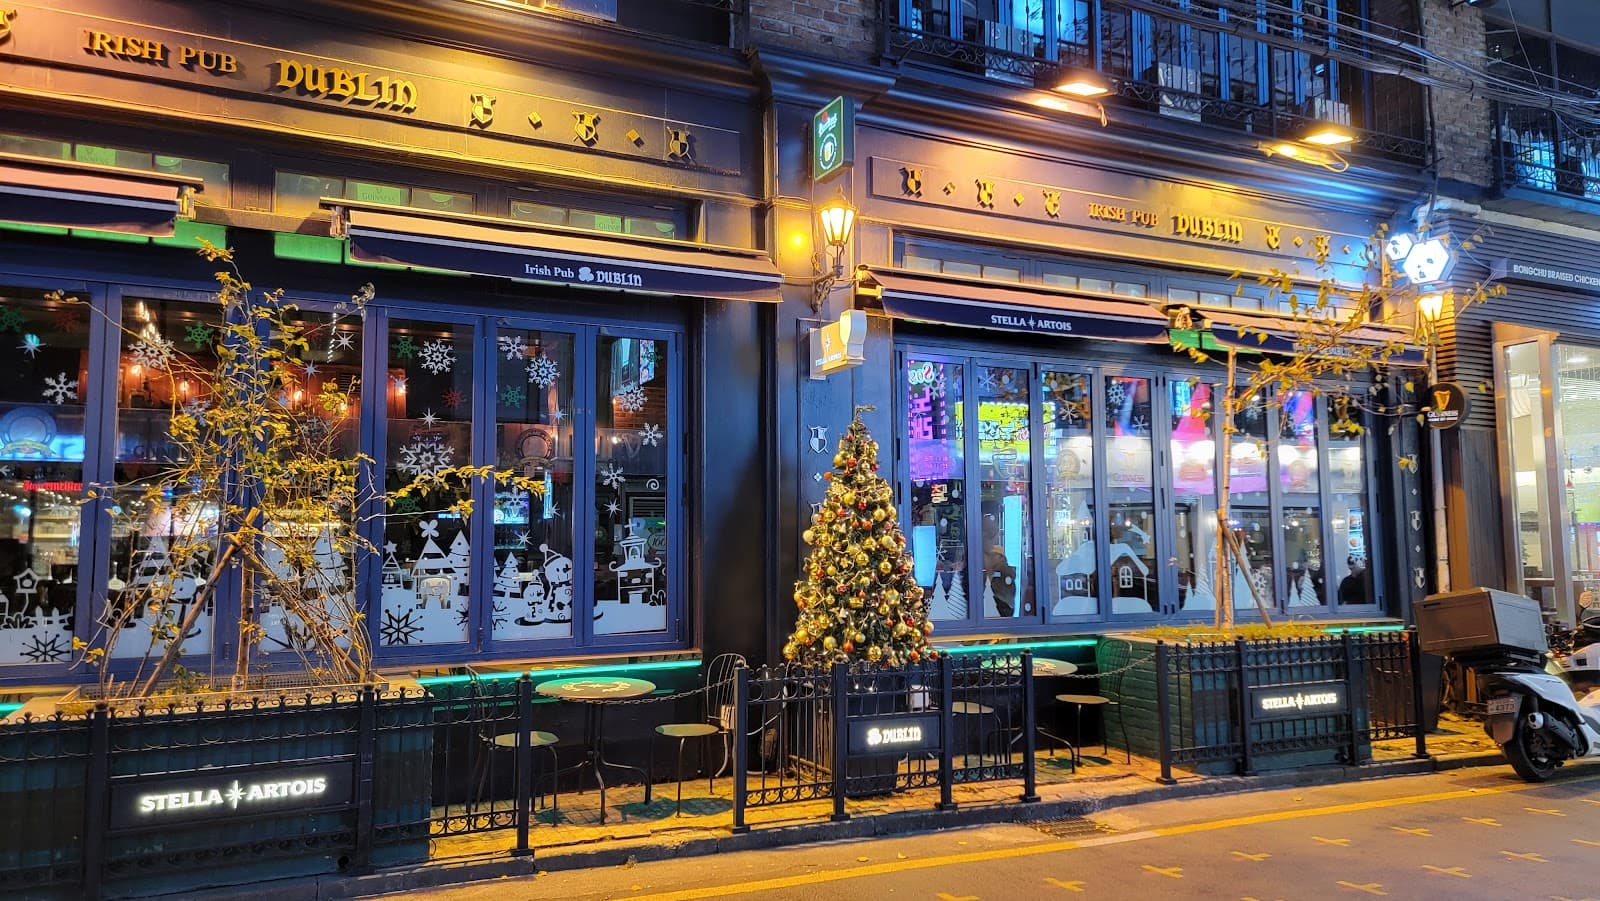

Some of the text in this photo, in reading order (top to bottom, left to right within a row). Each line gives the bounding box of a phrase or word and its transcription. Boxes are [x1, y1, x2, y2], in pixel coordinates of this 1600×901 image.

[84, 30, 418, 110] IRISH PUB DUBLIN
[1088, 202, 1243, 241] IRISH PUB DUBLIN
[525, 263, 643, 287] Irish Pub DUBLIN
[1513, 264, 1600, 286] BONGCHU BRAISED CHICKEN
[990, 314, 1072, 331] STELLA ARTOIS
[1262, 692, 1337, 710] STELLA ARTOIS
[882, 726, 922, 744] DUBLIN
[140, 777, 328, 813] STELLA ARTOIS
